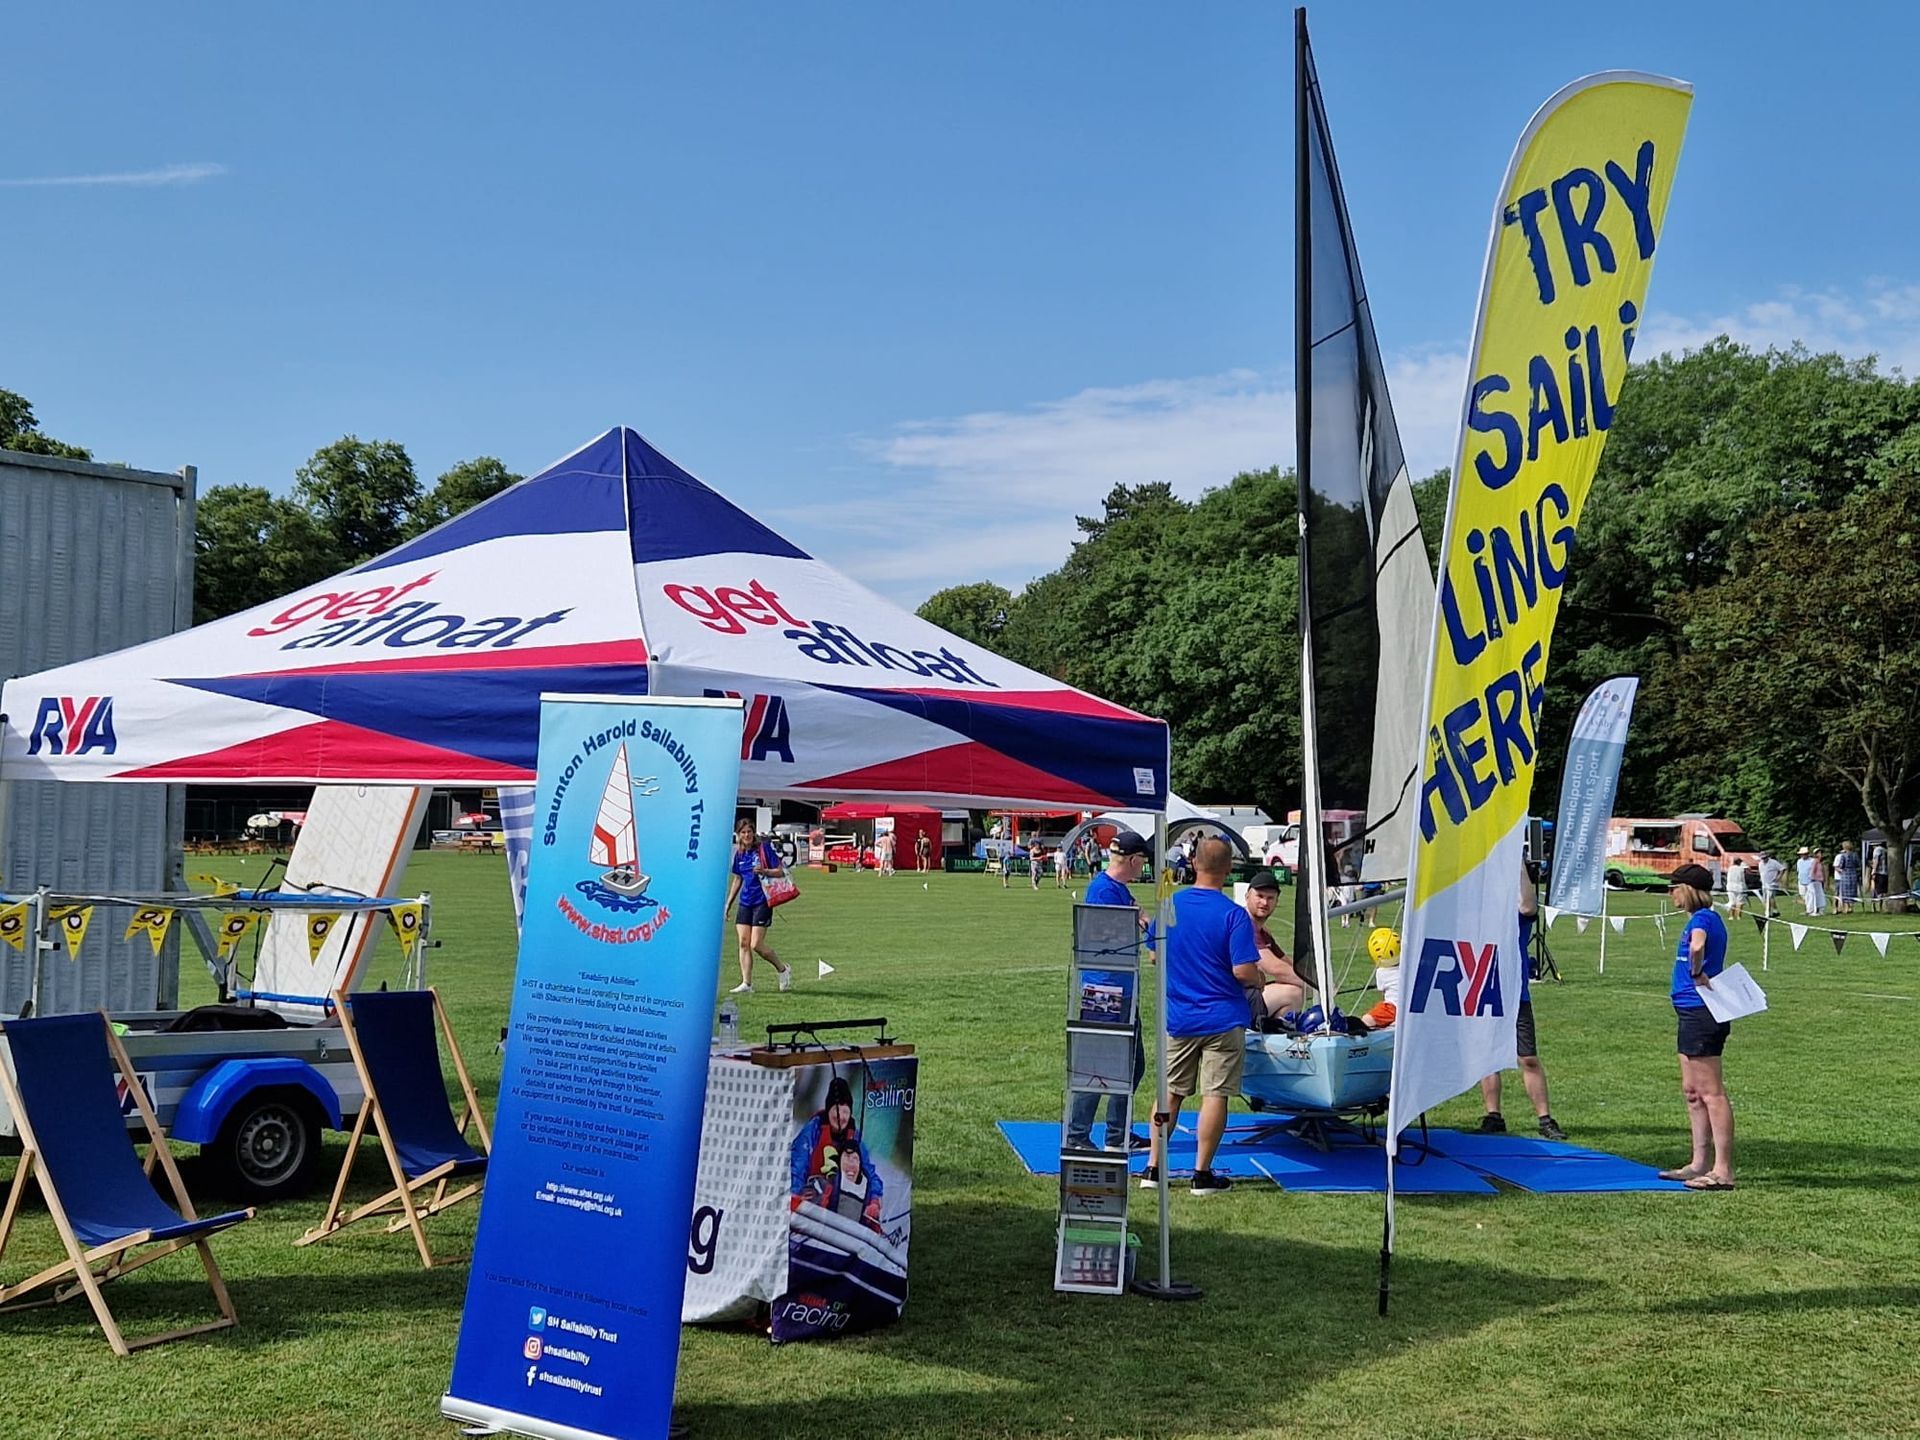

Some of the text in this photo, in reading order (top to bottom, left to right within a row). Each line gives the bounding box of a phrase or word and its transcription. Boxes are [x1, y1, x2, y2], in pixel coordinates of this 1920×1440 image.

[1503, 140, 1655, 304] TRY
[247, 569, 443, 637] get
[279, 601, 577, 651] afloat
[663, 578, 810, 635] get
[783, 620, 1002, 689] afloat
[26, 696, 117, 756] RYA
[544, 719, 704, 861] Staunton Harold Sailability Trust
[1585, 750, 1601, 785] Sport
[1582, 786, 1595, 801] in
[1555, 754, 1586, 908] Increasing Participation
[1572, 804, 1593, 883] Engagement
[558, 895, 670, 943] www.shst.org.uk
[1570, 884, 1581, 910] and
[1409, 937, 1505, 1017] RYA
[866, 1084, 915, 1111] sailing
[547, 1315, 618, 1344] SH Sailability Trust
[781, 1301, 851, 1332] racing
[543, 1344, 591, 1366] shsailability
[538, 1371, 603, 1397] shsailabilitytrust
